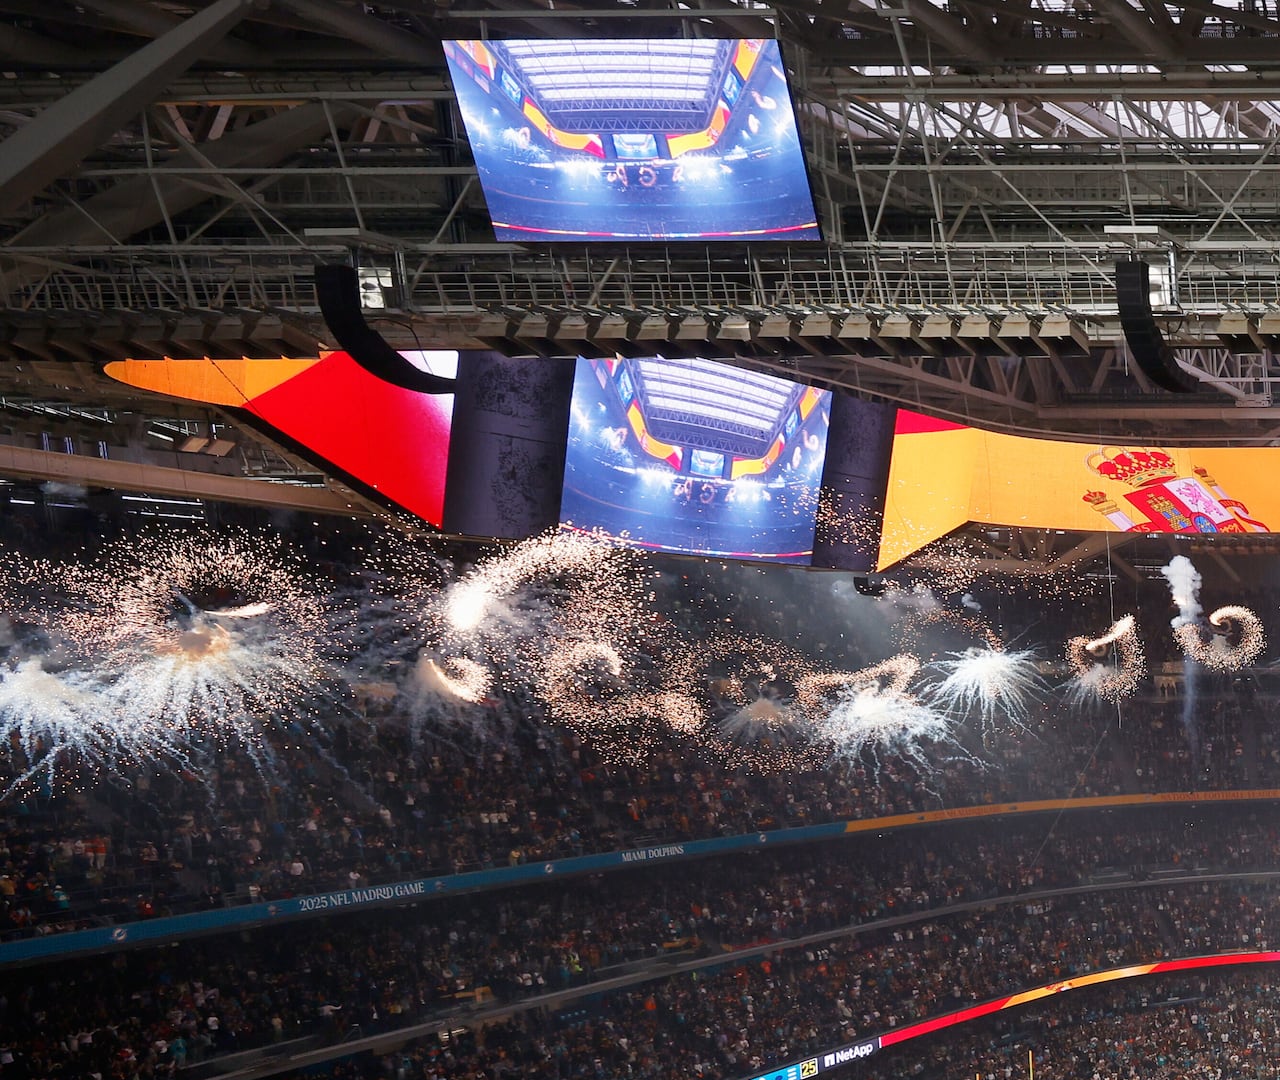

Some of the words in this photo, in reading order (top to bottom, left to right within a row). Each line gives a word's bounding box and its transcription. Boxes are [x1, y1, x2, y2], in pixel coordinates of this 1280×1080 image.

[621, 849, 646, 862] MIAMI
[648, 845, 684, 859] DOLPHINS
[299, 895, 328, 911] 2025
[330, 891, 351, 908] NFL
[352, 886, 393, 904] MADRID
[395, 881, 425, 897] GAME
[802, 1061, 816, 1077] 25
[835, 1043, 873, 1064] NetApp
